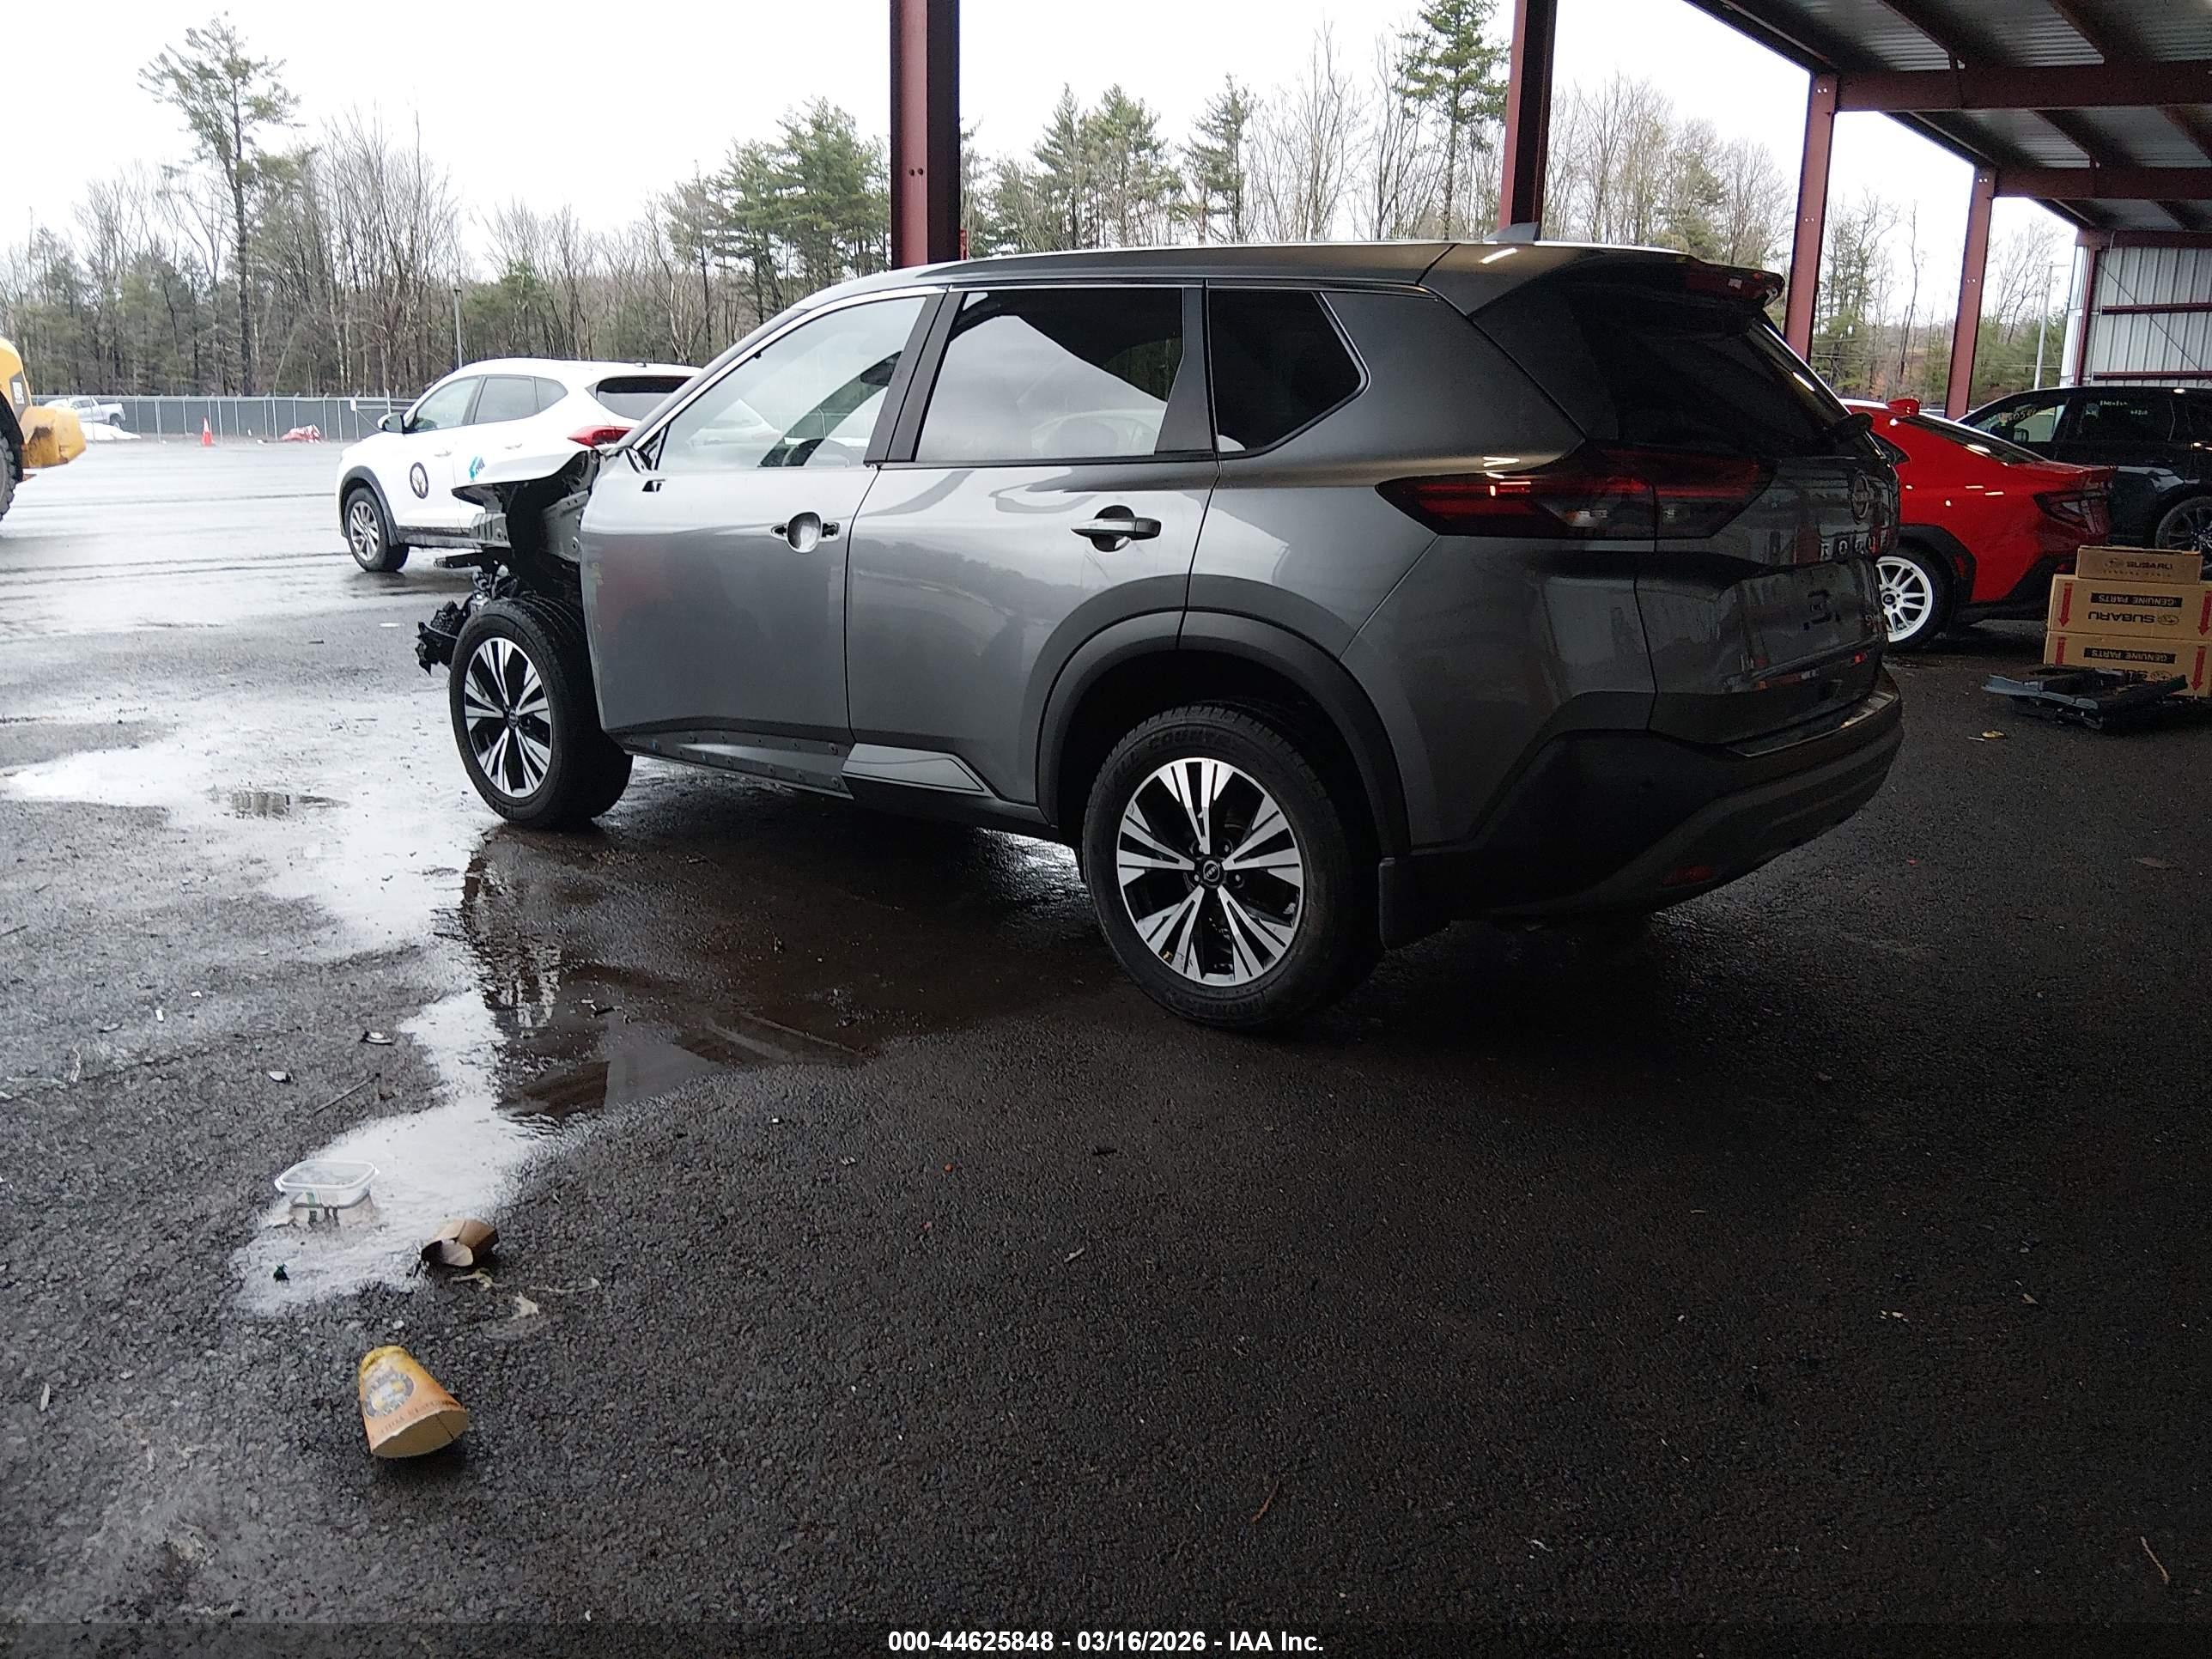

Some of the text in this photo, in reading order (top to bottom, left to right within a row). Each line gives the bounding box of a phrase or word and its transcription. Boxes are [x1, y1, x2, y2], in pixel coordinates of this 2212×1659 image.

[2126, 561, 2172, 570] SUBARU
[2098, 592, 2175, 606] GENUINE PARTS
[2087, 611, 2156, 623] SUBARU
[2091, 648, 2168, 662] GENUINE PARTS
